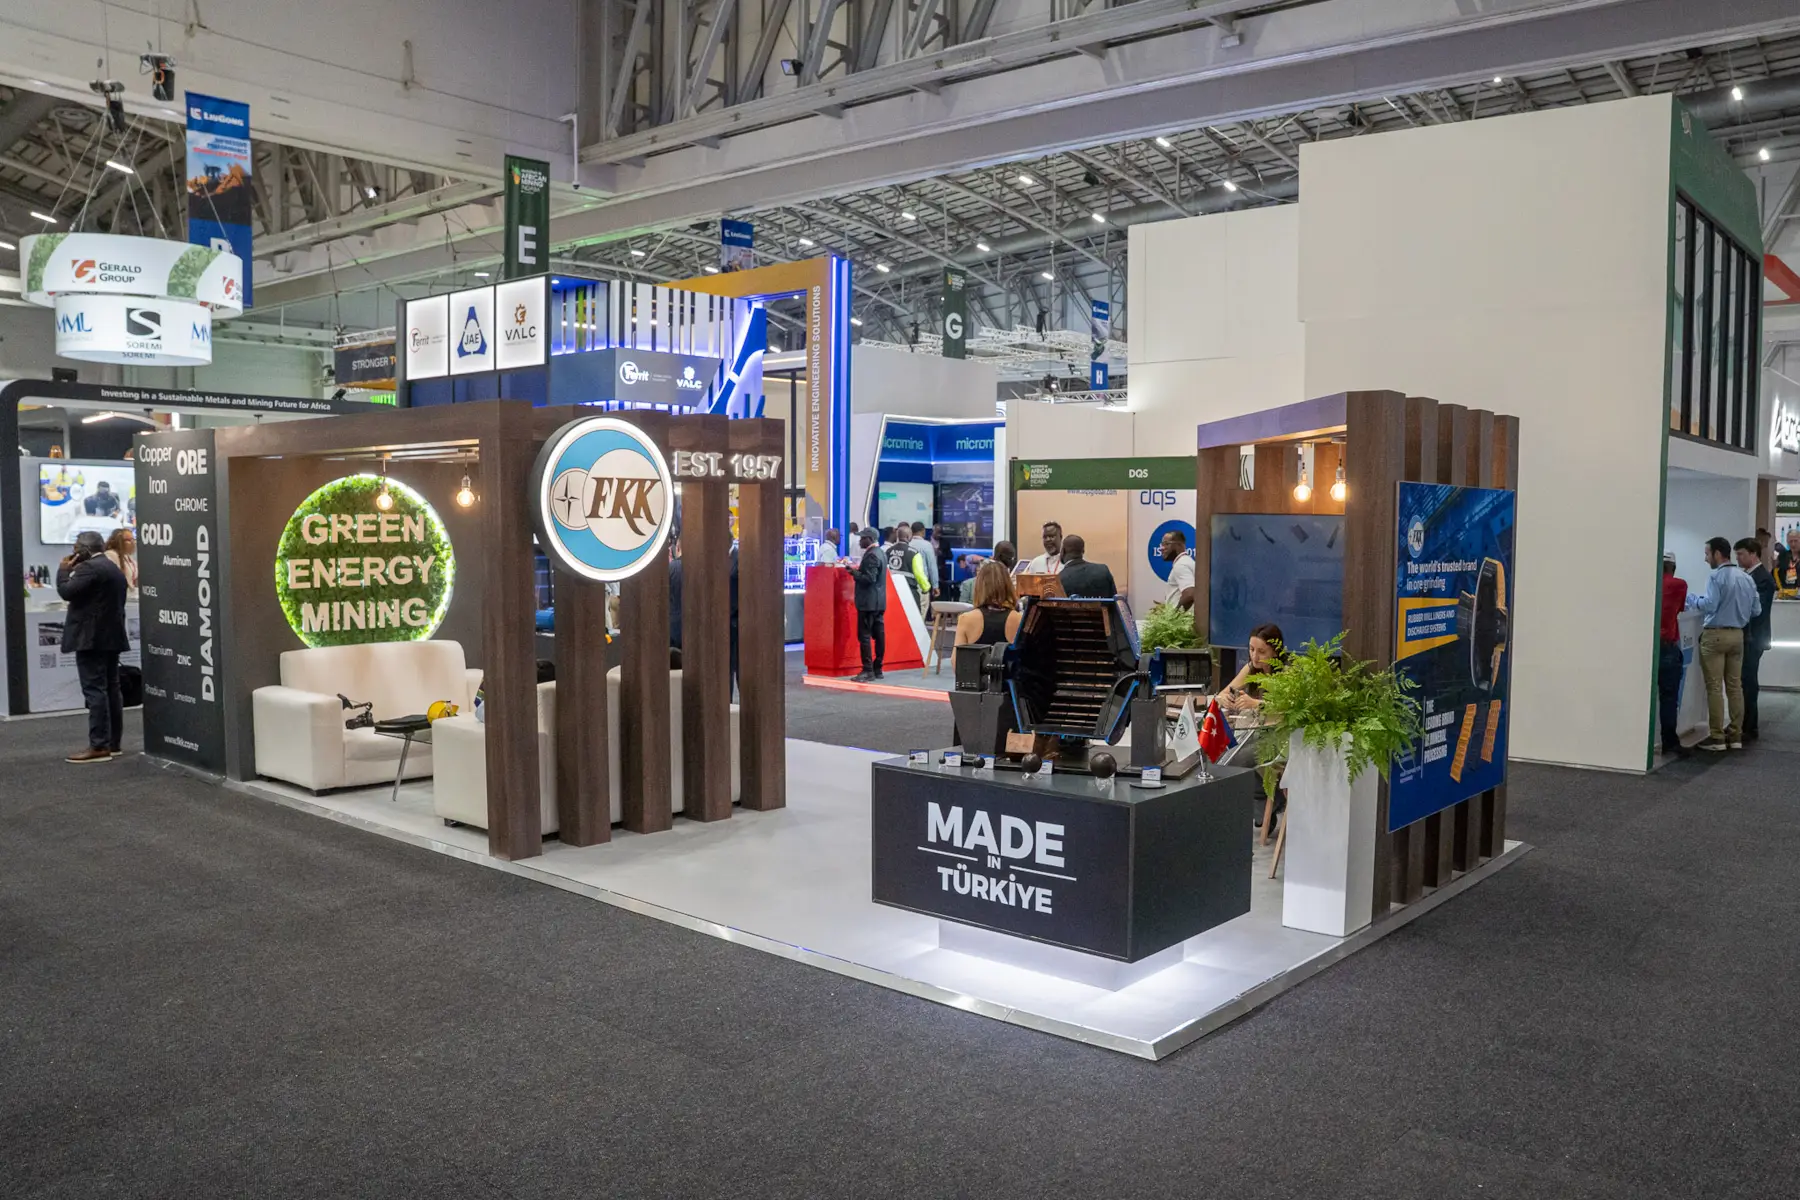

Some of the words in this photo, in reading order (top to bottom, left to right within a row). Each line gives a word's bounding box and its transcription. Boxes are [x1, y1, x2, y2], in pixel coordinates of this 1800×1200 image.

[518, 225, 537, 265] E
[99, 262, 142, 274] GERALD
[99, 273, 135, 283] GROUP
[812, 285, 821, 342] SOLUTIONS
[945, 312, 963, 340] G
[126, 341, 162, 350] SOREMI
[464, 333, 479, 345] JAE
[352, 356, 388, 371] STRONGER
[811, 345, 821, 413] ENGINEERING
[101, 389, 140, 400] Investing
[141, 391, 150, 400] in
[158, 392, 204, 403] Sustainable
[205, 395, 231, 405] Metals
[232, 397, 246, 406] and
[248, 398, 273, 408] Mining
[274, 400, 298, 410] Future
[299, 401, 309, 410] for
[310, 402, 331, 411] Africa
[811, 414, 821, 472] INNOVATIVE
[882, 436, 924, 450] icromine
[139, 444, 172, 466] Copper
[176, 449, 208, 475] ORE
[673, 450, 725, 477] EST.
[730, 453, 782, 479] 1957
[149, 475, 167, 494] Iron
[1128, 468, 1149, 479] DQS
[175, 498, 208, 512] CHROME
[586, 476, 662, 536] FKK
[1140, 489, 1176, 511] dqs
[141, 523, 173, 546] GOLD
[301, 512, 425, 546] GREEN
[162, 555, 192, 567] Aluminum
[288, 555, 436, 589] ENERGY
[1407, 561, 1419, 574] The
[1419, 560, 1441, 573] world's
[1441, 559, 1462, 573] trusted
[1462, 559, 1478, 571] brand
[1406, 578, 1415, 591] in
[1415, 579, 1424, 590] ore
[1423, 577, 1446, 592] grinding
[159, 609, 188, 626] SILVER
[196, 524, 215, 702] DIAMOND
[301, 597, 428, 634] MINING
[1407, 613, 1424, 623] RUBBER
[1446, 610, 1455, 619] AND
[177, 654, 192, 666] ZINC
[927, 801, 1065, 868] MADE
[987, 855, 1001, 870] IN
[937, 863, 1053, 914] TÜRKİYE
